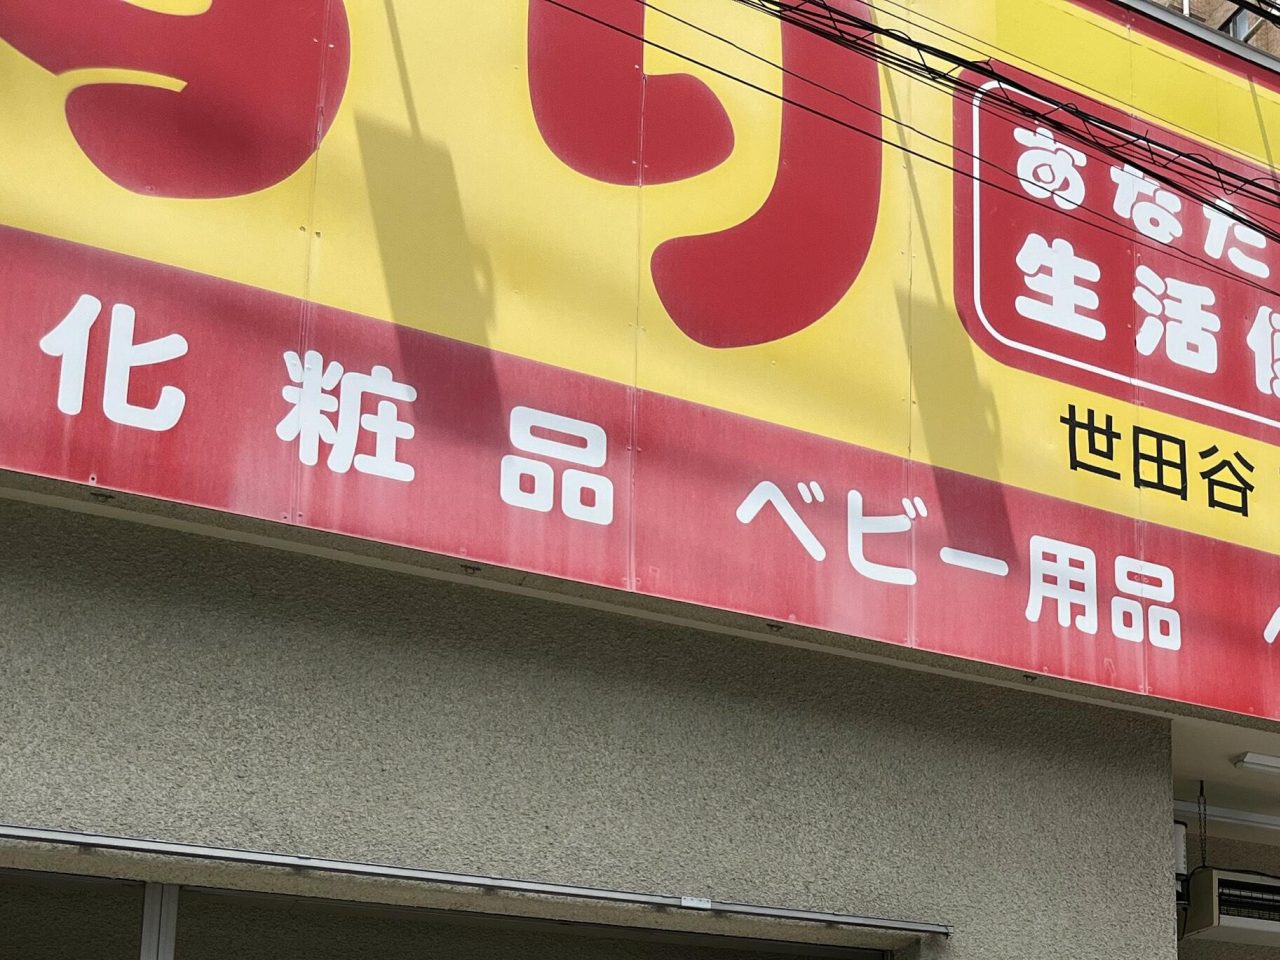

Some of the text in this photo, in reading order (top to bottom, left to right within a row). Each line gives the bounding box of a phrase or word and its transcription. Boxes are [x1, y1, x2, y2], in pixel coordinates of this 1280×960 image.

[39, 293, 614, 526] 化粧品
[735, 479, 1182, 651] ベビー用品
